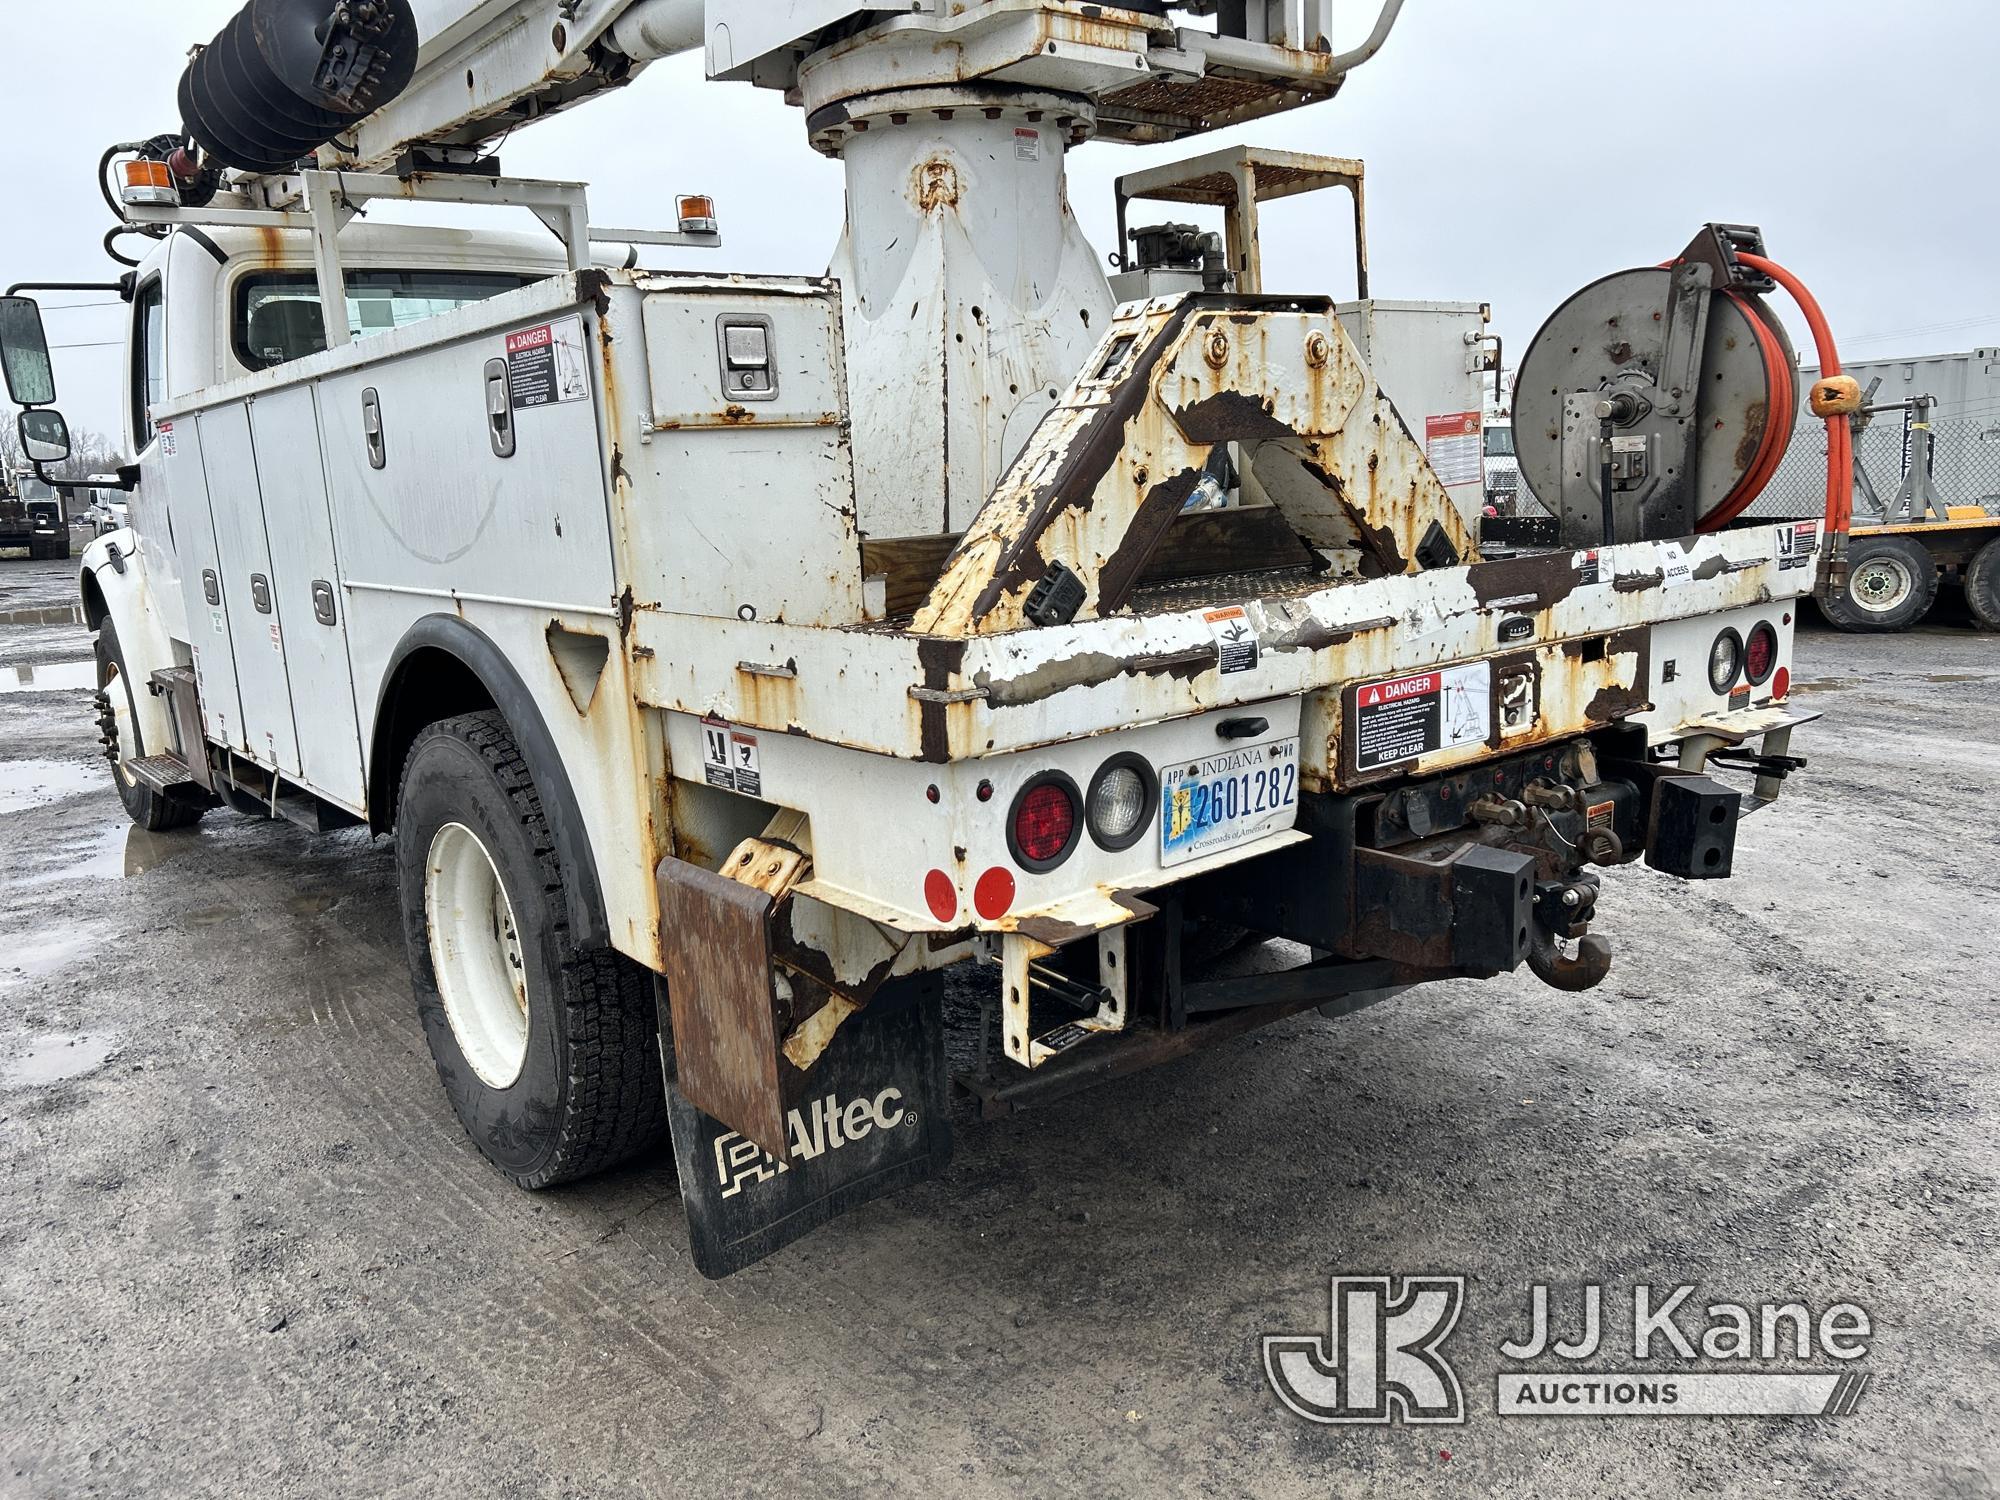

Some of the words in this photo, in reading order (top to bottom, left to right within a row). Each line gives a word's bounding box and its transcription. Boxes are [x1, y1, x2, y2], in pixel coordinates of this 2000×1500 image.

[516, 329, 548, 347] DANGER
[1666, 550, 1677, 560] NO
[1666, 565, 1690, 577] ACCESS
[1213, 609, 1242, 618] WARNING
[1385, 677, 1431, 698] DANGER
[1378, 701, 1403, 711] ELECTRICAL
[1279, 743, 1294, 759] PWR
[1378, 748, 1399, 762] KEEP
[1399, 742, 1424, 756] CLEAR
[1202, 749, 1263, 777] INDIANA
[1167, 769, 1184, 785] APP
[1196, 763, 1295, 829] 2601282
[1193, 832, 1231, 851] Crossroads
[1231, 829, 1241, 841] of
[1239, 824, 1266, 838] America
[787, 1087, 904, 1161] Altec
